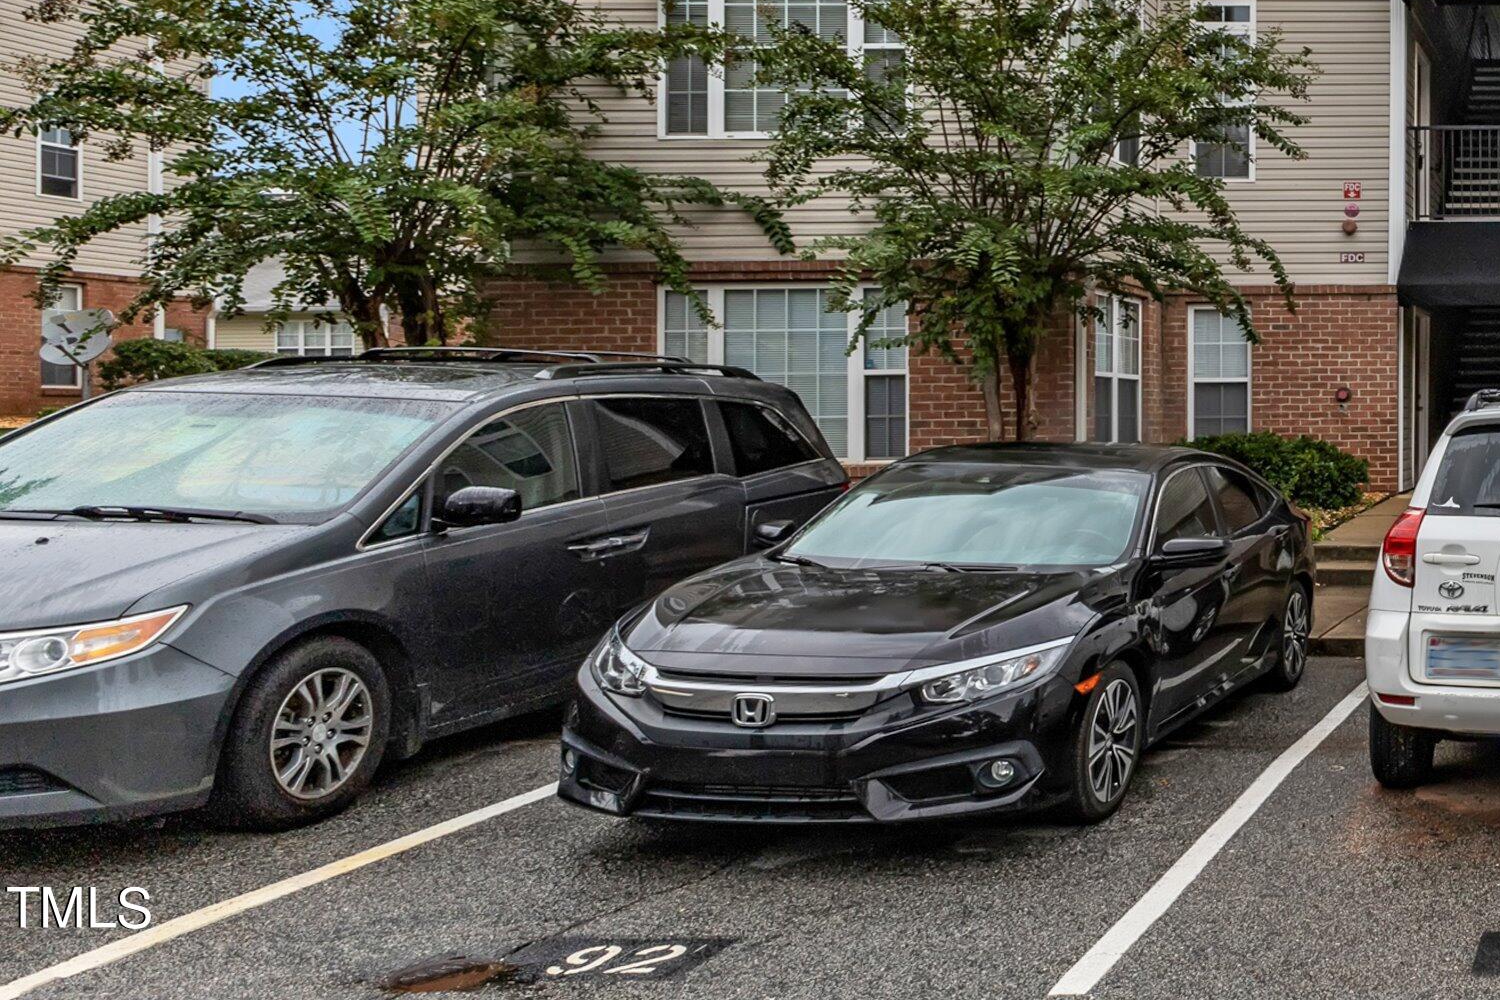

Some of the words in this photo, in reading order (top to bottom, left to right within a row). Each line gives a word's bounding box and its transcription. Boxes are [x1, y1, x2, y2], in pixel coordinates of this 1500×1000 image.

[1344, 183, 1360, 192] FDC
[1341, 253, 1364, 262] FDC
[546, 945, 687, 975] 92
